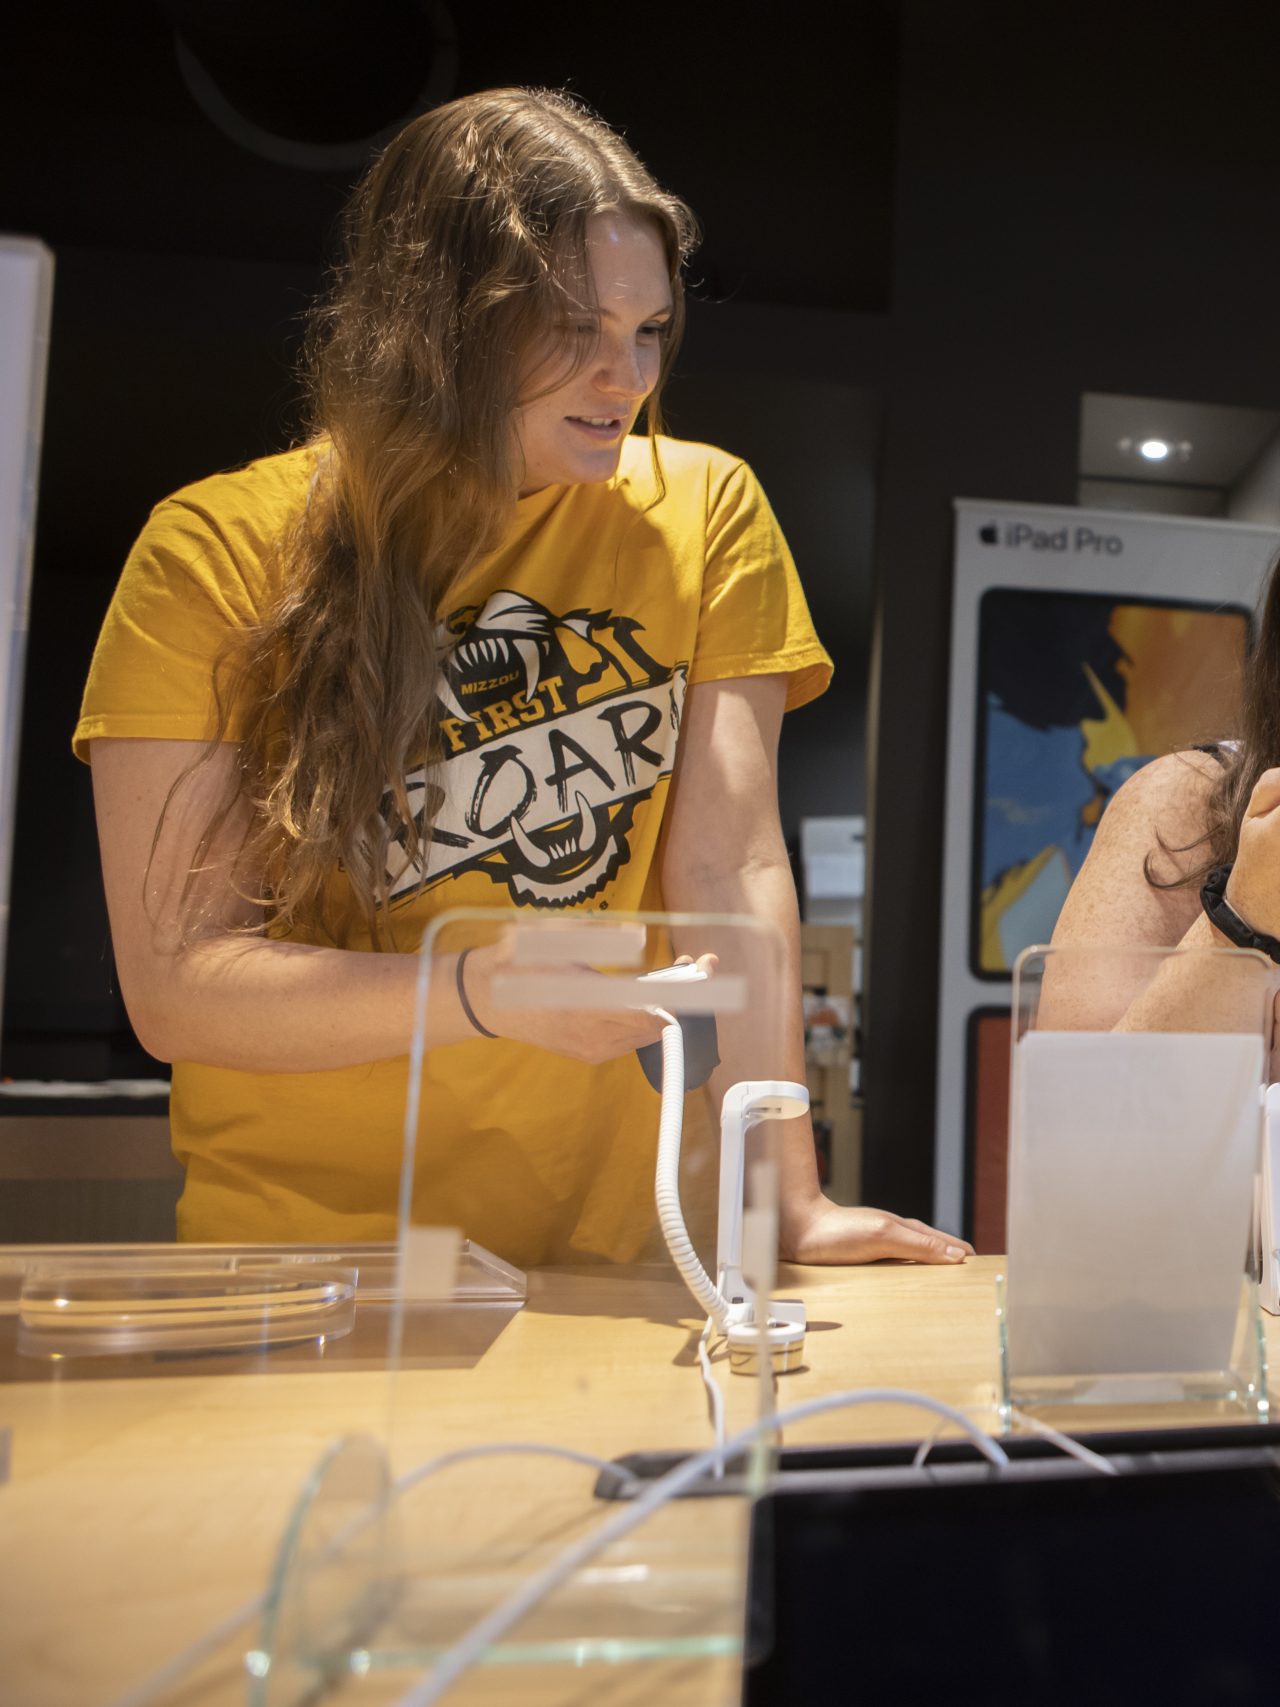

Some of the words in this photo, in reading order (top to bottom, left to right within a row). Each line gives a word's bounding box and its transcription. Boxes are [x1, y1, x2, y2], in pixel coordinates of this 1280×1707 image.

[1005, 523, 1069, 550] iPad
[1076, 526, 1124, 555] Pro
[460, 670, 520, 696] MIZZOU
[439, 675, 568, 753] FIRST
